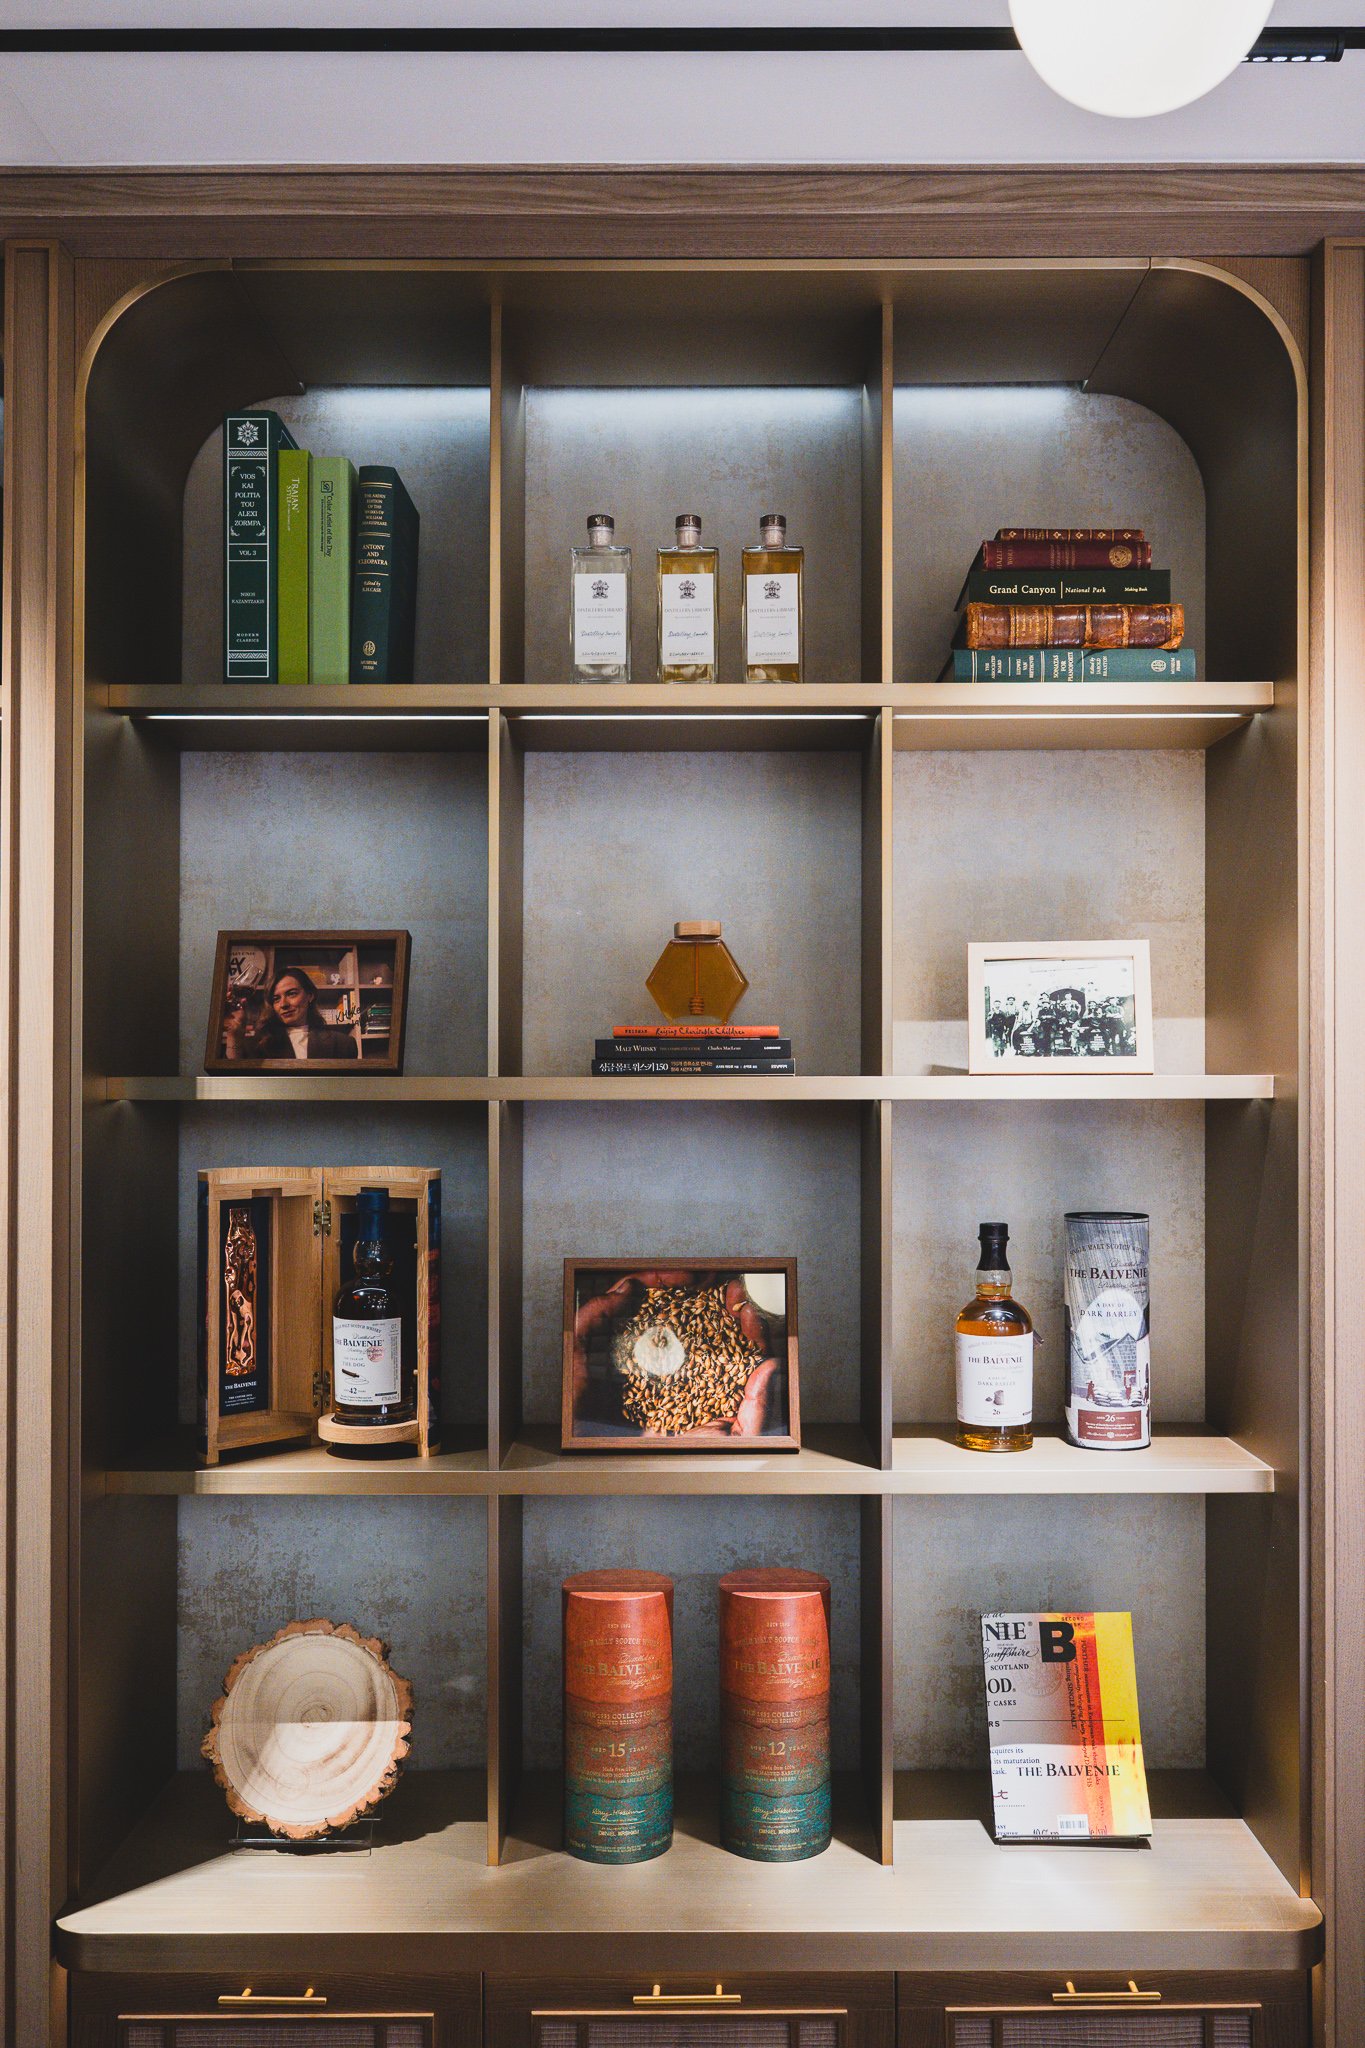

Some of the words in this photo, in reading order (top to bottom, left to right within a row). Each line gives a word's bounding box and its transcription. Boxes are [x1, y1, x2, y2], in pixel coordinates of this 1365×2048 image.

[989, 585, 1018, 594] Grand
[1021, 585, 1056, 595] Canyon
[655, 1027, 677, 1036] Raising
[679, 1027, 714, 1035] Charitable
[715, 1027, 744, 1036] Children
[1070, 1269, 1086, 1279] THE
[1090, 1268, 1148, 1279] BALVENIE
[343, 1338, 382, 1347] BALVENIE
[983, 1356, 1022, 1364] BALVENIE
[233, 1381, 256, 1389] BALVENIE
[992, 1408, 1000, 1416] 26
[1105, 1414, 1116, 1422] 26
[615, 1637, 640, 1645] SCOTCH
[1039, 1622, 1076, 1663] B
[598, 1659, 663, 1677] BALVENIE
[757, 1658, 820, 1675] BALVENIE
[990, 1663, 1029, 1671] SCOTLAND
[1067, 1682, 1075, 1708] SINGLE
[612, 1709, 657, 1719] COLLECTION
[609, 1742, 626, 1758] 15
[768, 1741, 786, 1756] 12
[1016, 1767, 1042, 1777] THE
[1046, 1763, 1120, 1777] BALVENIE
